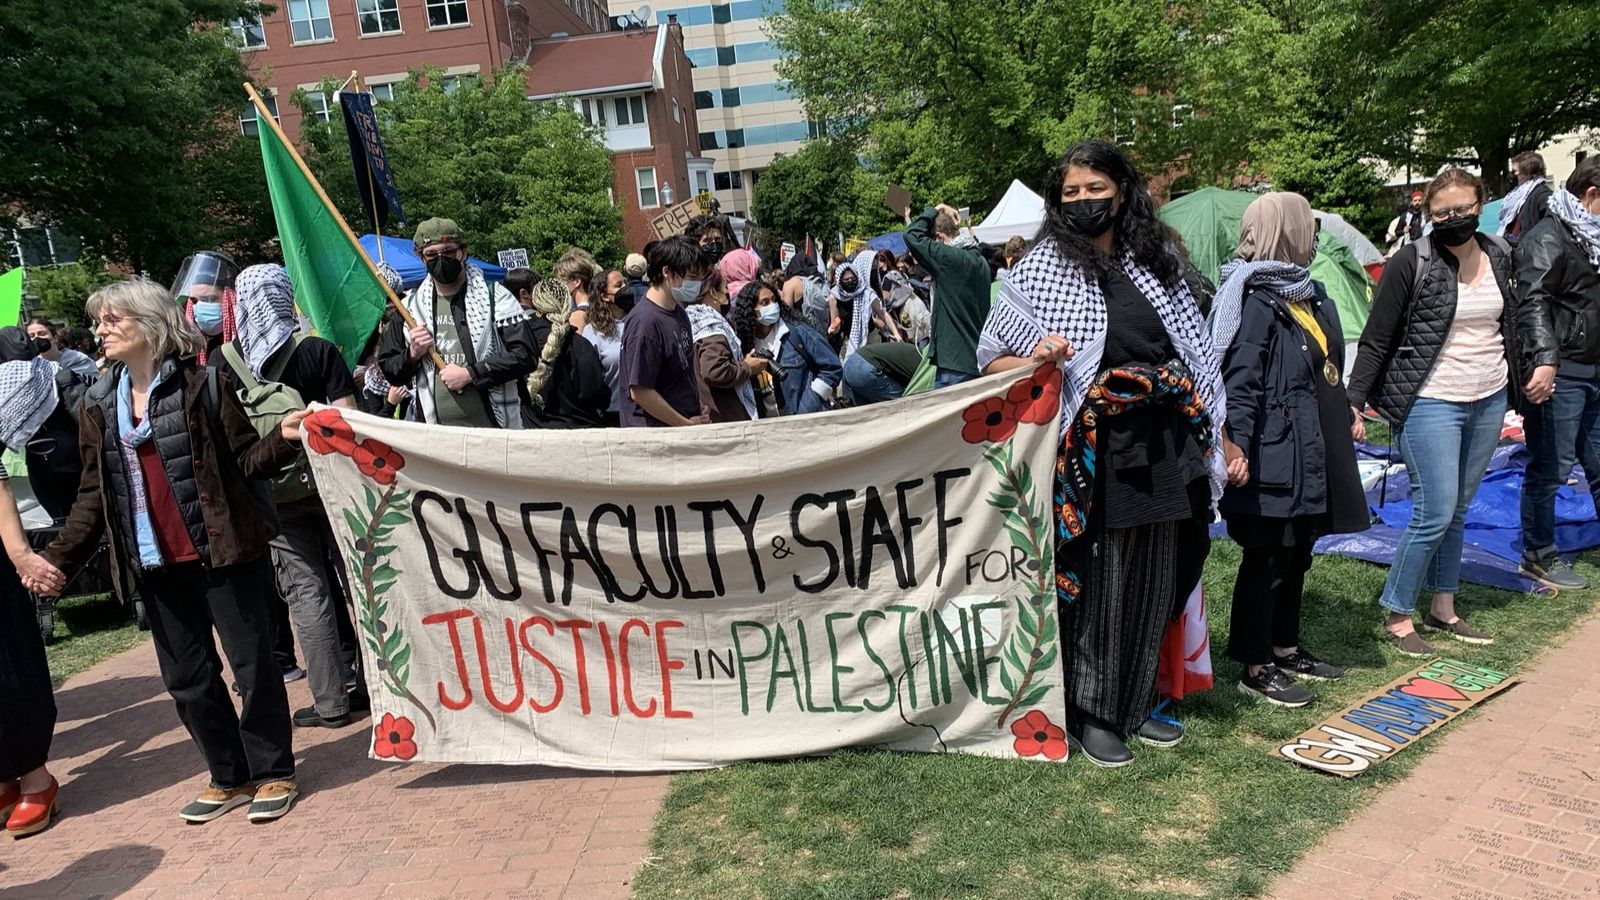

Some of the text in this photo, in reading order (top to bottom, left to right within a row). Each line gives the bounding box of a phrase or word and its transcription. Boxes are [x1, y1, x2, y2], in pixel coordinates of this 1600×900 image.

[698, 193, 710, 202] END
[653, 200, 693, 239] FREE
[502, 259, 528, 269] END THE
[411, 468, 1034, 605] GU FACULTY & STAFF FOR
[421, 601, 1013, 719] JUSTICE IN PALESTINE
[1279, 660, 1509, 772] GW ALUM GAZA
[1476, 848, 1498, 857] 2010
[1499, 864, 1539, 878] WILLIAM
